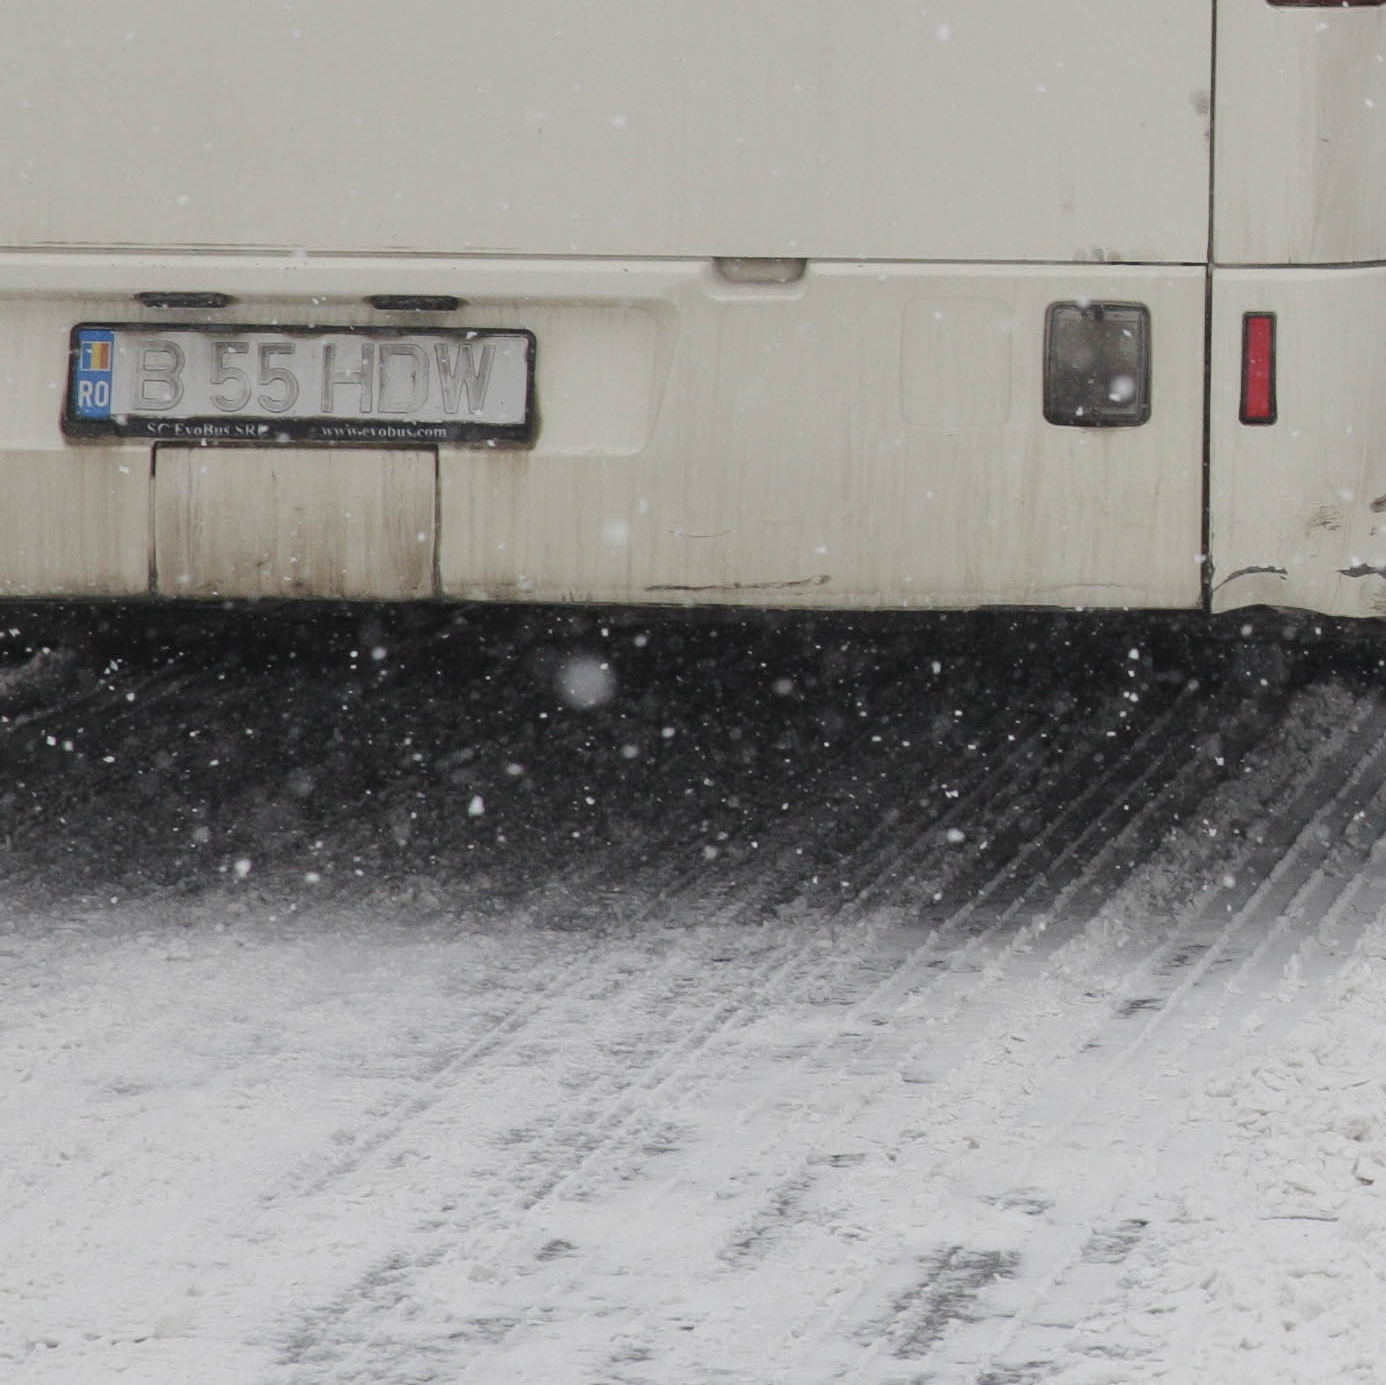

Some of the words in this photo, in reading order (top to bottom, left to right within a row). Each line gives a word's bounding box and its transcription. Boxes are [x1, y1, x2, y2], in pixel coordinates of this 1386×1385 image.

[133, 339, 186, 411] B
[210, 341, 300, 414] 55
[320, 342, 496, 415] HDW
[77, 379, 110, 408] RO
[174, 422, 231, 437] EvoBus
